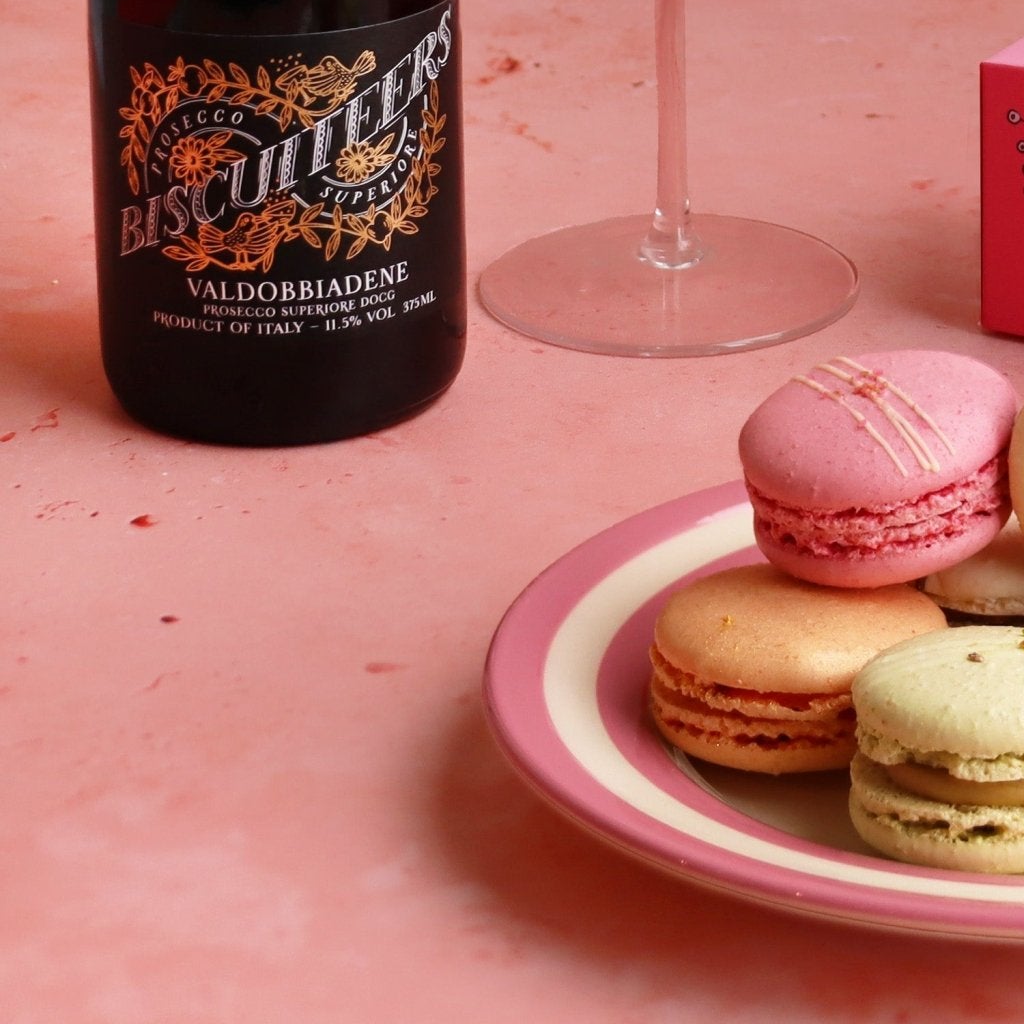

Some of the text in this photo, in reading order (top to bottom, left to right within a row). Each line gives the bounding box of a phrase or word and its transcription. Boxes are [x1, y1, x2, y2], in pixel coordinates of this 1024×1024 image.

[120, 9, 453, 257] BISCUITEERS
[151, 108, 245, 174] PROSECCO
[319, 128, 418, 206] SUPERIORE
[186, 261, 409, 302] VALDOBBIADENE
[203, 289, 396, 318] PROSECCO SUPERIORE DOCG
[153, 310, 225, 333] PRODUCT
[232, 321, 252, 334] OF
[257, 321, 304, 335] ITALY
[324, 315, 362, 332] 11.5%
[366, 308, 397, 323] VOL
[402, 289, 438, 315] 375ML
